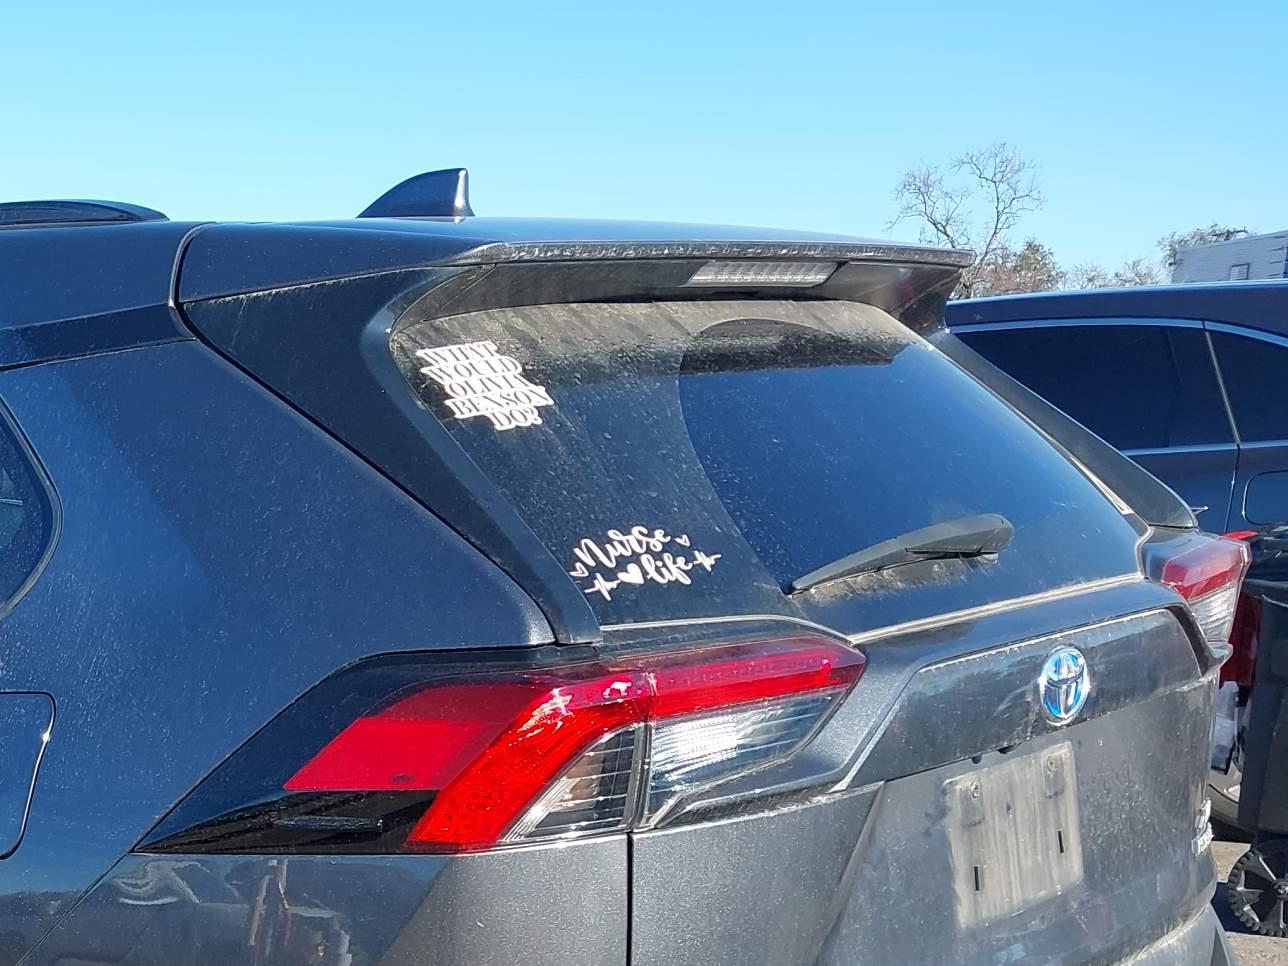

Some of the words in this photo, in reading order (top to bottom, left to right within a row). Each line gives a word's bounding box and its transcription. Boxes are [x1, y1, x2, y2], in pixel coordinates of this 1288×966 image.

[418, 343, 497, 366] WHAT
[422, 357, 521, 384] WOULD
[447, 374, 532, 398] OLIVIA
[446, 388, 552, 417] BENSON
[490, 406, 541, 429] DO?
[573, 525, 672, 569] Nurse
[641, 553, 693, 585] life
